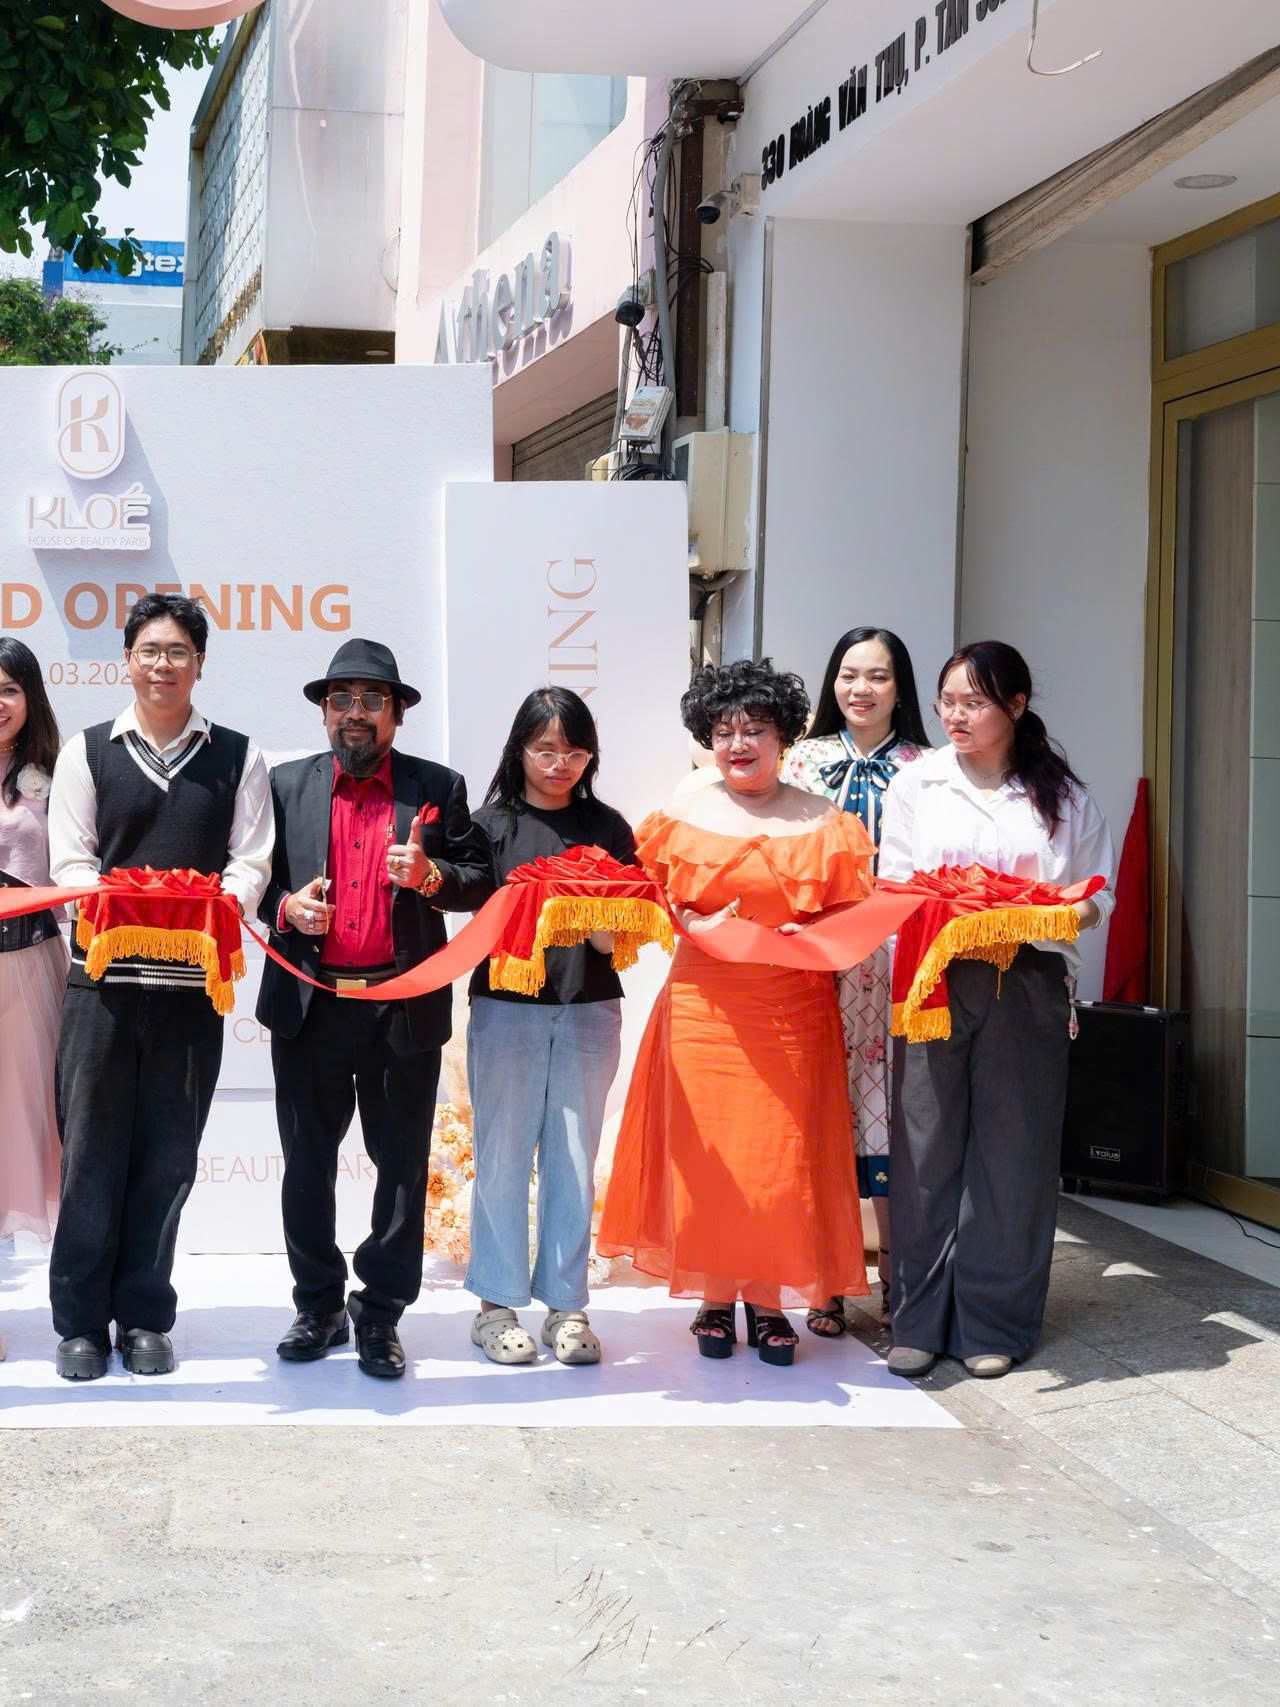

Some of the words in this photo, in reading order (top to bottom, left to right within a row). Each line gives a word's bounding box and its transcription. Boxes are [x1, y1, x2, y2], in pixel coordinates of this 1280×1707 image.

[762, 134, 785, 191] 330
[789, 96, 831, 170] HOÀNG
[839, 65, 867, 131] VĂN
[875, 32, 909, 103] THỤ,
[915, 16, 930, 72] P.
[29, 485, 148, 530] KLOÉ
[28, 536, 62, 546] HOUSE
[64, 536, 78, 546] OF
[81, 536, 117, 546] BEAUTY
[120, 536, 147, 546] PARIS
[64, 582, 351, 632] OPNING
[195, 1157, 283, 1183] BEAUT
